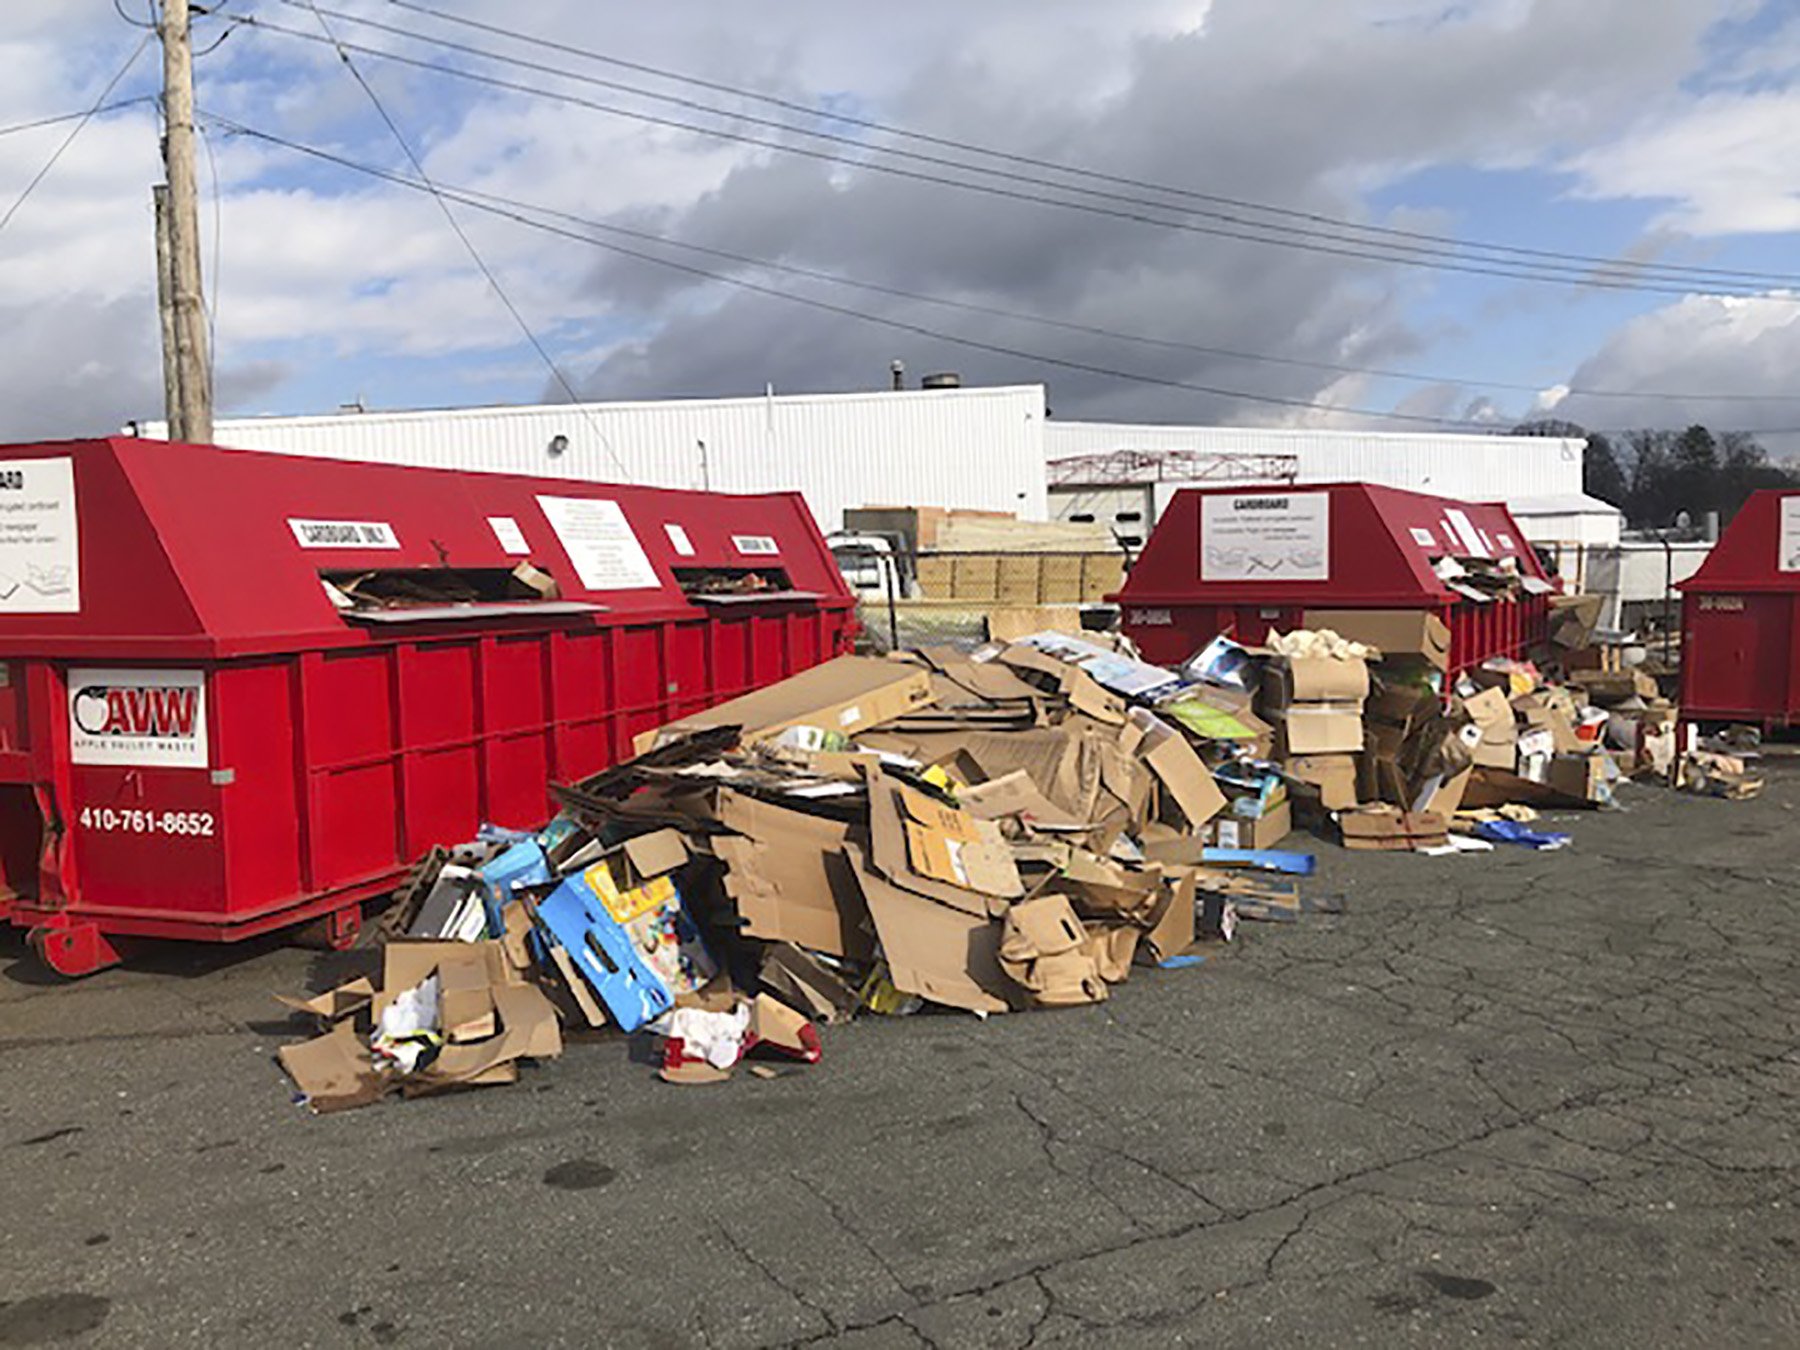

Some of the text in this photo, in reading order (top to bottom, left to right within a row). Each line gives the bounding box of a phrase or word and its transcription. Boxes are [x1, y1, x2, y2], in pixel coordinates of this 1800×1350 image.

[1233, 498, 1289, 510] CARDBOARD
[300, 524, 361, 543] CARDBOARD
[100, 687, 199, 736] AVW
[80, 806, 214, 836] 410-761-8652
